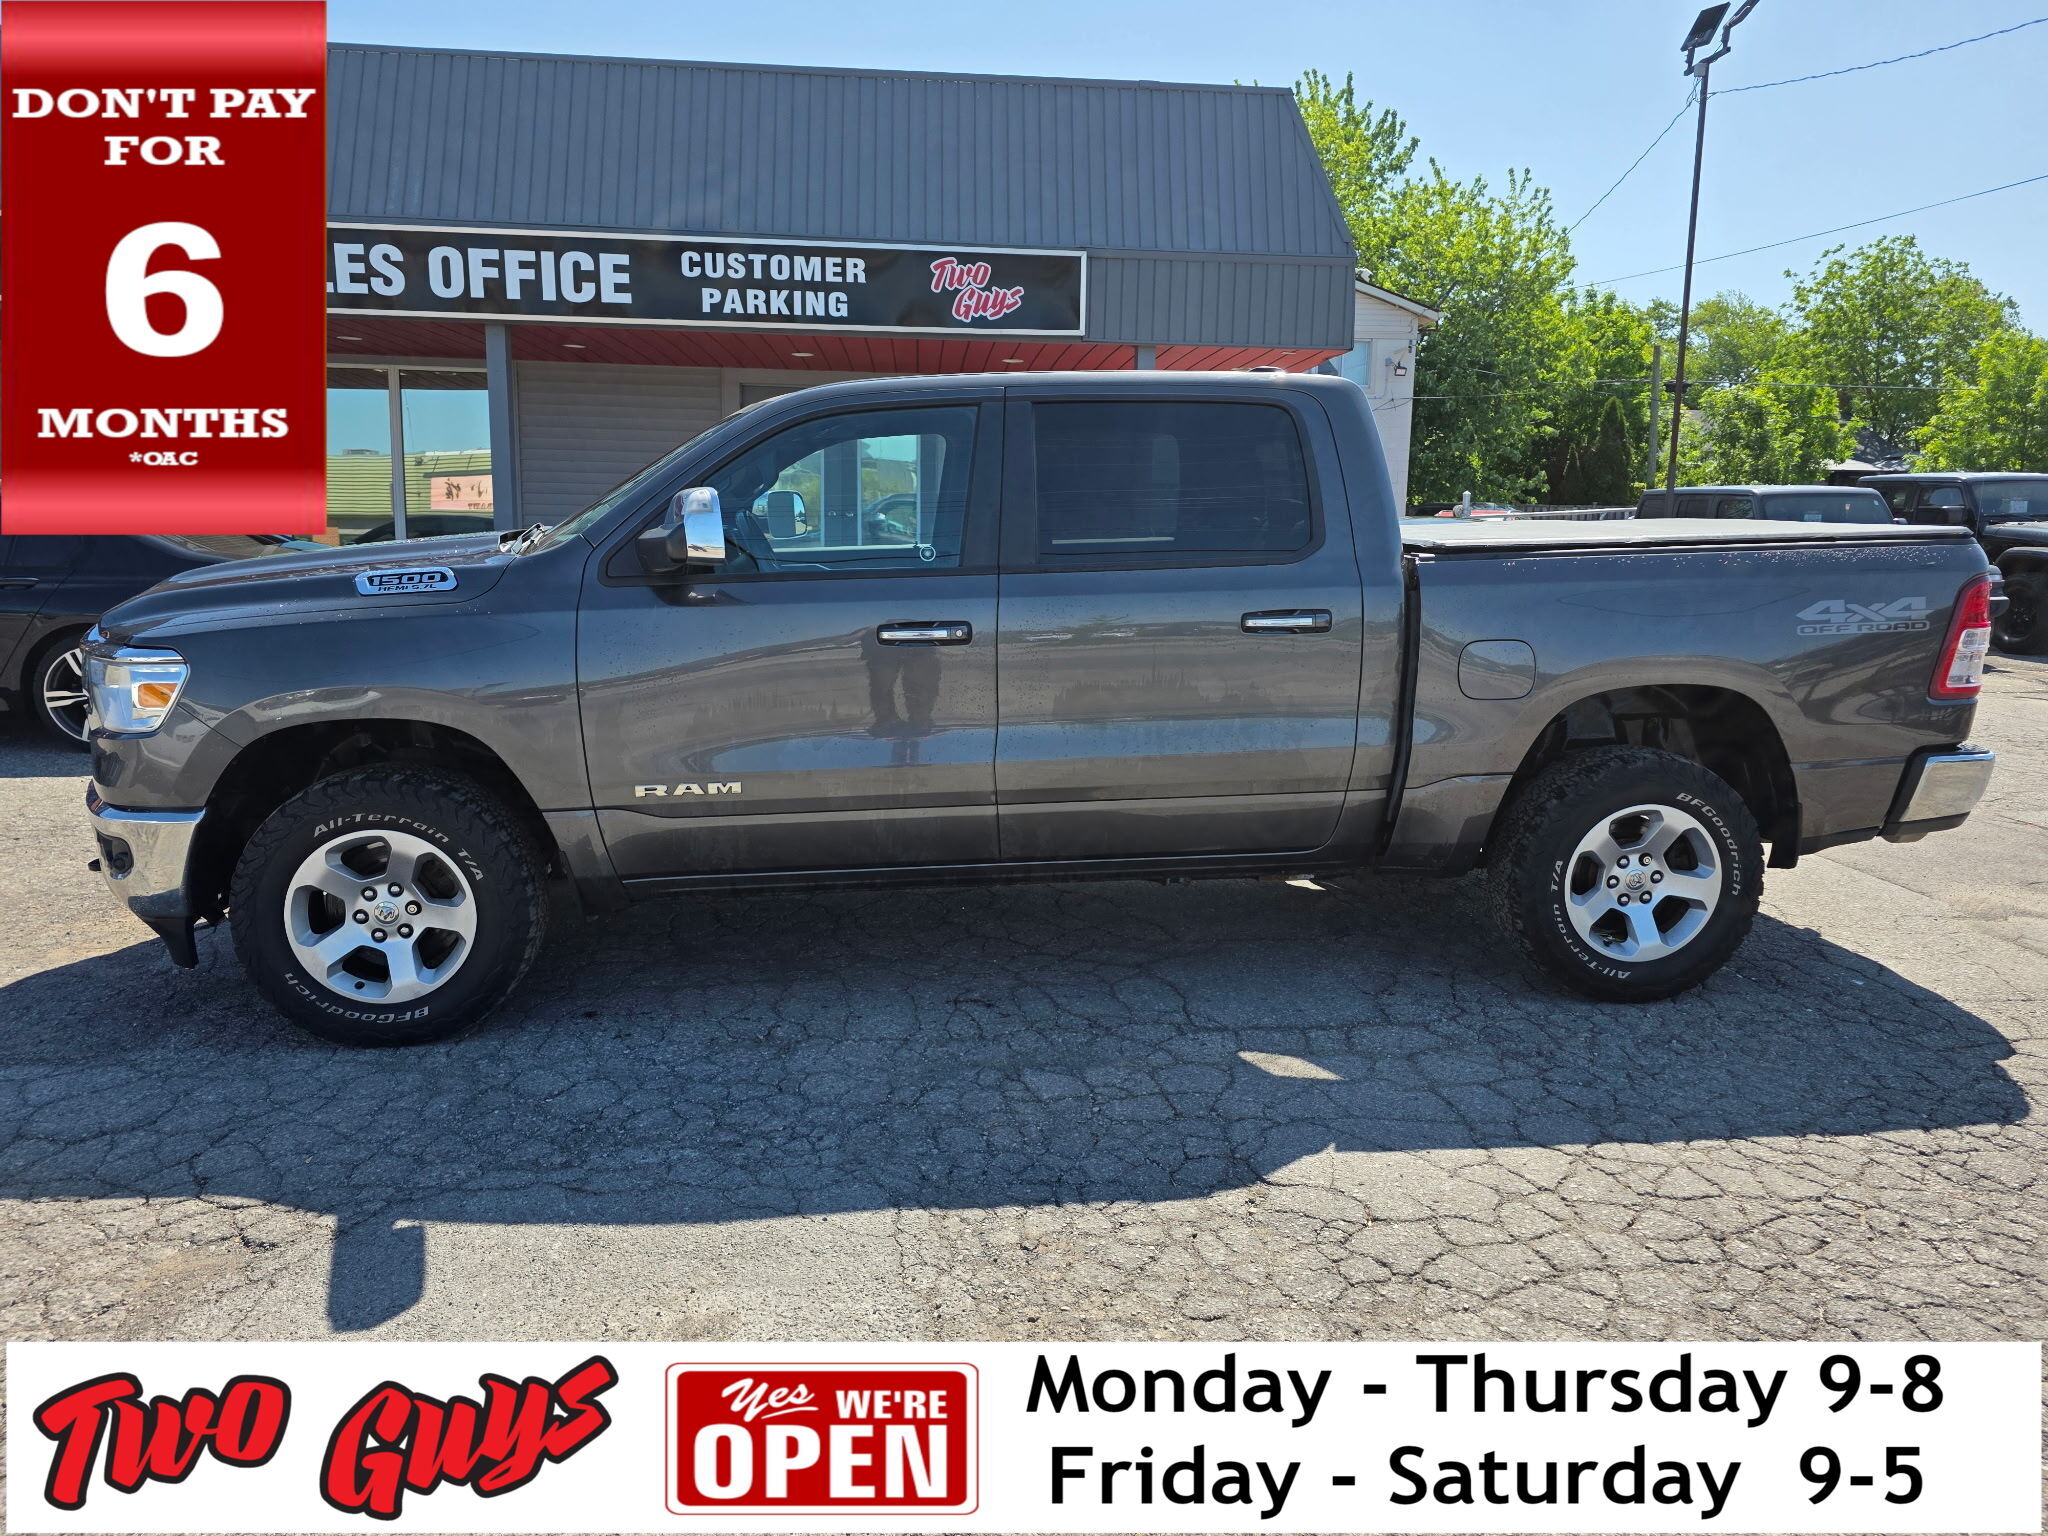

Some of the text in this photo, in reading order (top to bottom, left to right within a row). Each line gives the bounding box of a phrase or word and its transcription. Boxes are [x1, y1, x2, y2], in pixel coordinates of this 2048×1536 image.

[326, 242, 633, 304] ES OFFICE
[680, 251, 867, 284] CUSTOMER
[930, 256, 992, 293] Two
[701, 287, 849, 318] PARKING
[952, 285, 1025, 323] Guys
[369, 572, 442, 586] 1500
[1799, 621, 1929, 634] OFF ROAD
[635, 781, 742, 798] RAM
[313, 812, 484, 881] All-Terrain T/A
[1675, 792, 1742, 896] BFGoodrich
[1550, 860, 1632, 979] All-Terrain T/A
[284, 972, 430, 1024] BFGoodrich
